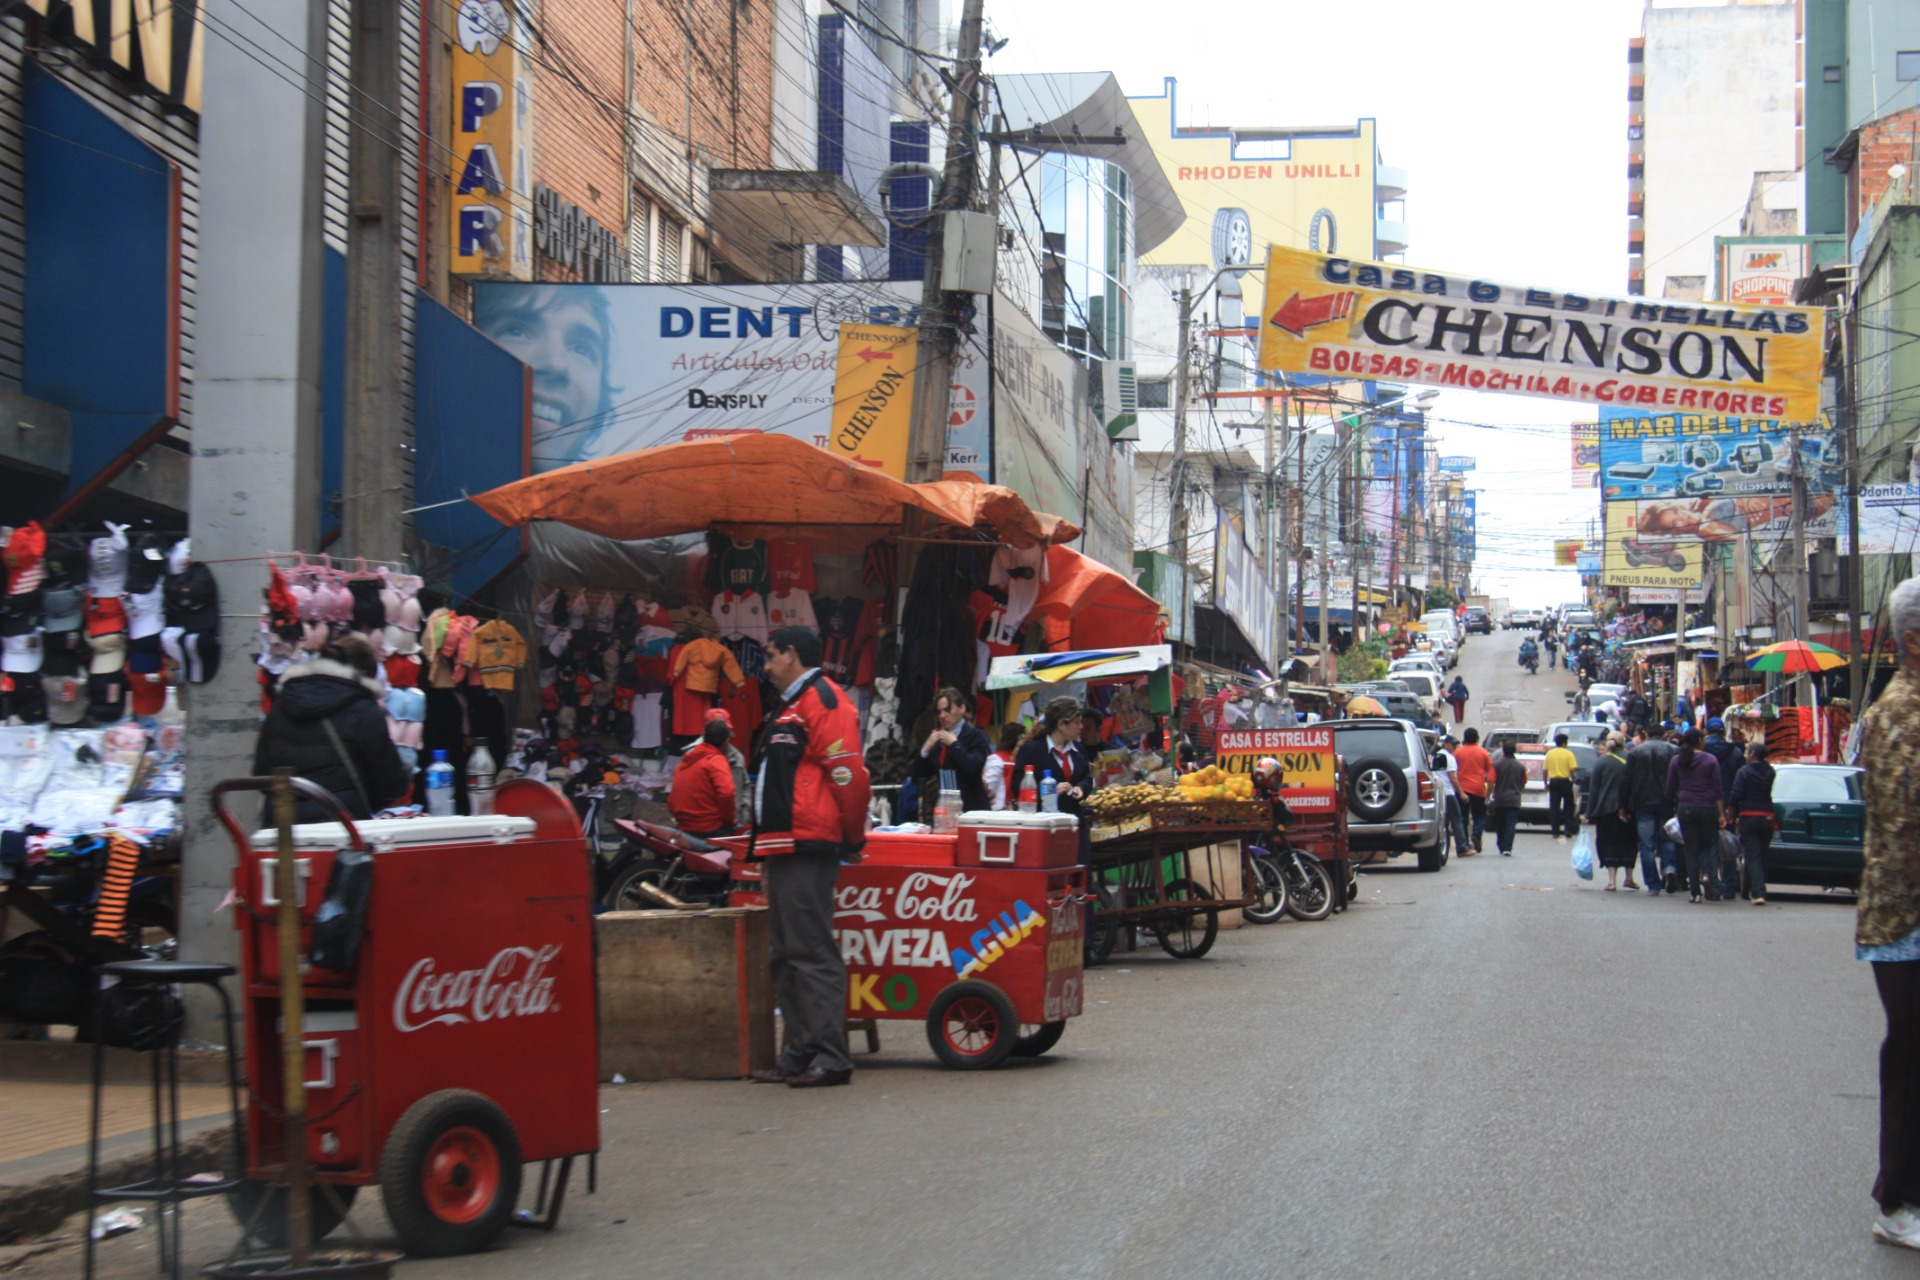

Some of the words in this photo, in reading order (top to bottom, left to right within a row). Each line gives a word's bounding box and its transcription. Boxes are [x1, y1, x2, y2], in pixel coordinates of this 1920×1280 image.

[1178, 165, 1272, 181] RHODEN
[1284, 164, 1361, 179] UNILLI
[1468, 279, 1501, 303] 6
[1525, 286, 1811, 335] ESTRELLAS
[846, 331, 909, 345] CHENSON
[1362, 297, 1770, 384] CHENSON
[1308, 346, 1419, 379] BOLSAS
[1594, 379, 1786, 417] COBERTORES
[837, 365, 905, 452] CHENSON
[1610, 418, 1676, 440] MAR
[1681, 414, 1736, 436] DEL
[1858, 485, 1902, 498] Odonto
[1610, 574, 1640, 584] PNEUS
[1643, 576, 1667, 585] PARA
[1669, 577, 1696, 587] MOTO
[1221, 732, 1252, 748] CASA
[1254, 733, 1262, 748] 6
[1264, 731, 1330, 748] ESTRELLAS
[832, 928, 952, 968] RVEZA
[950, 899, 1046, 981] AGUA
[392, 943, 564, 1033] Coca-Cola
